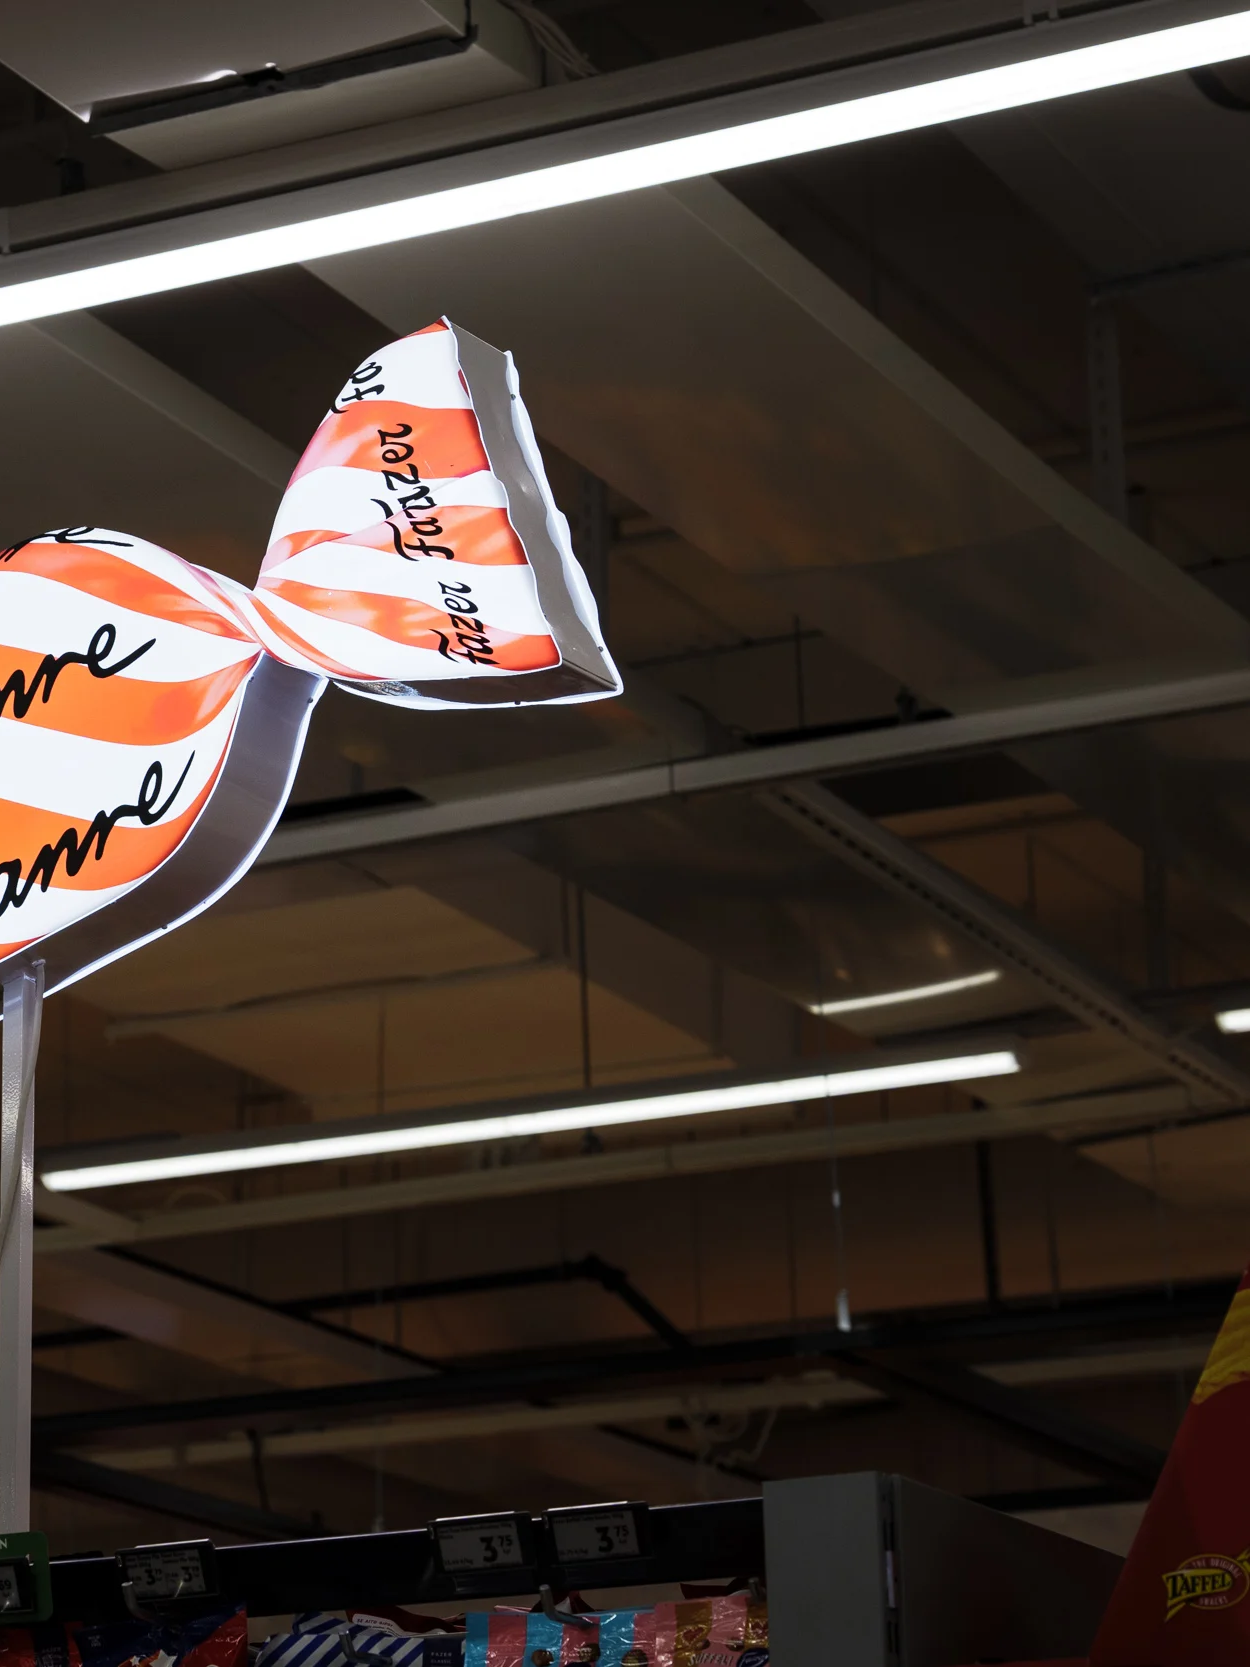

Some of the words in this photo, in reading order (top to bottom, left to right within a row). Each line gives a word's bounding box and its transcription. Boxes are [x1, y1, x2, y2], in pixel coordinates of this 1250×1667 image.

[429, 580, 501, 665] Fazer
[480, 1536, 498, 1562] 3
[595, 1527, 613, 1552] 3
[1167, 1573, 1231, 1599] TAFFEL
